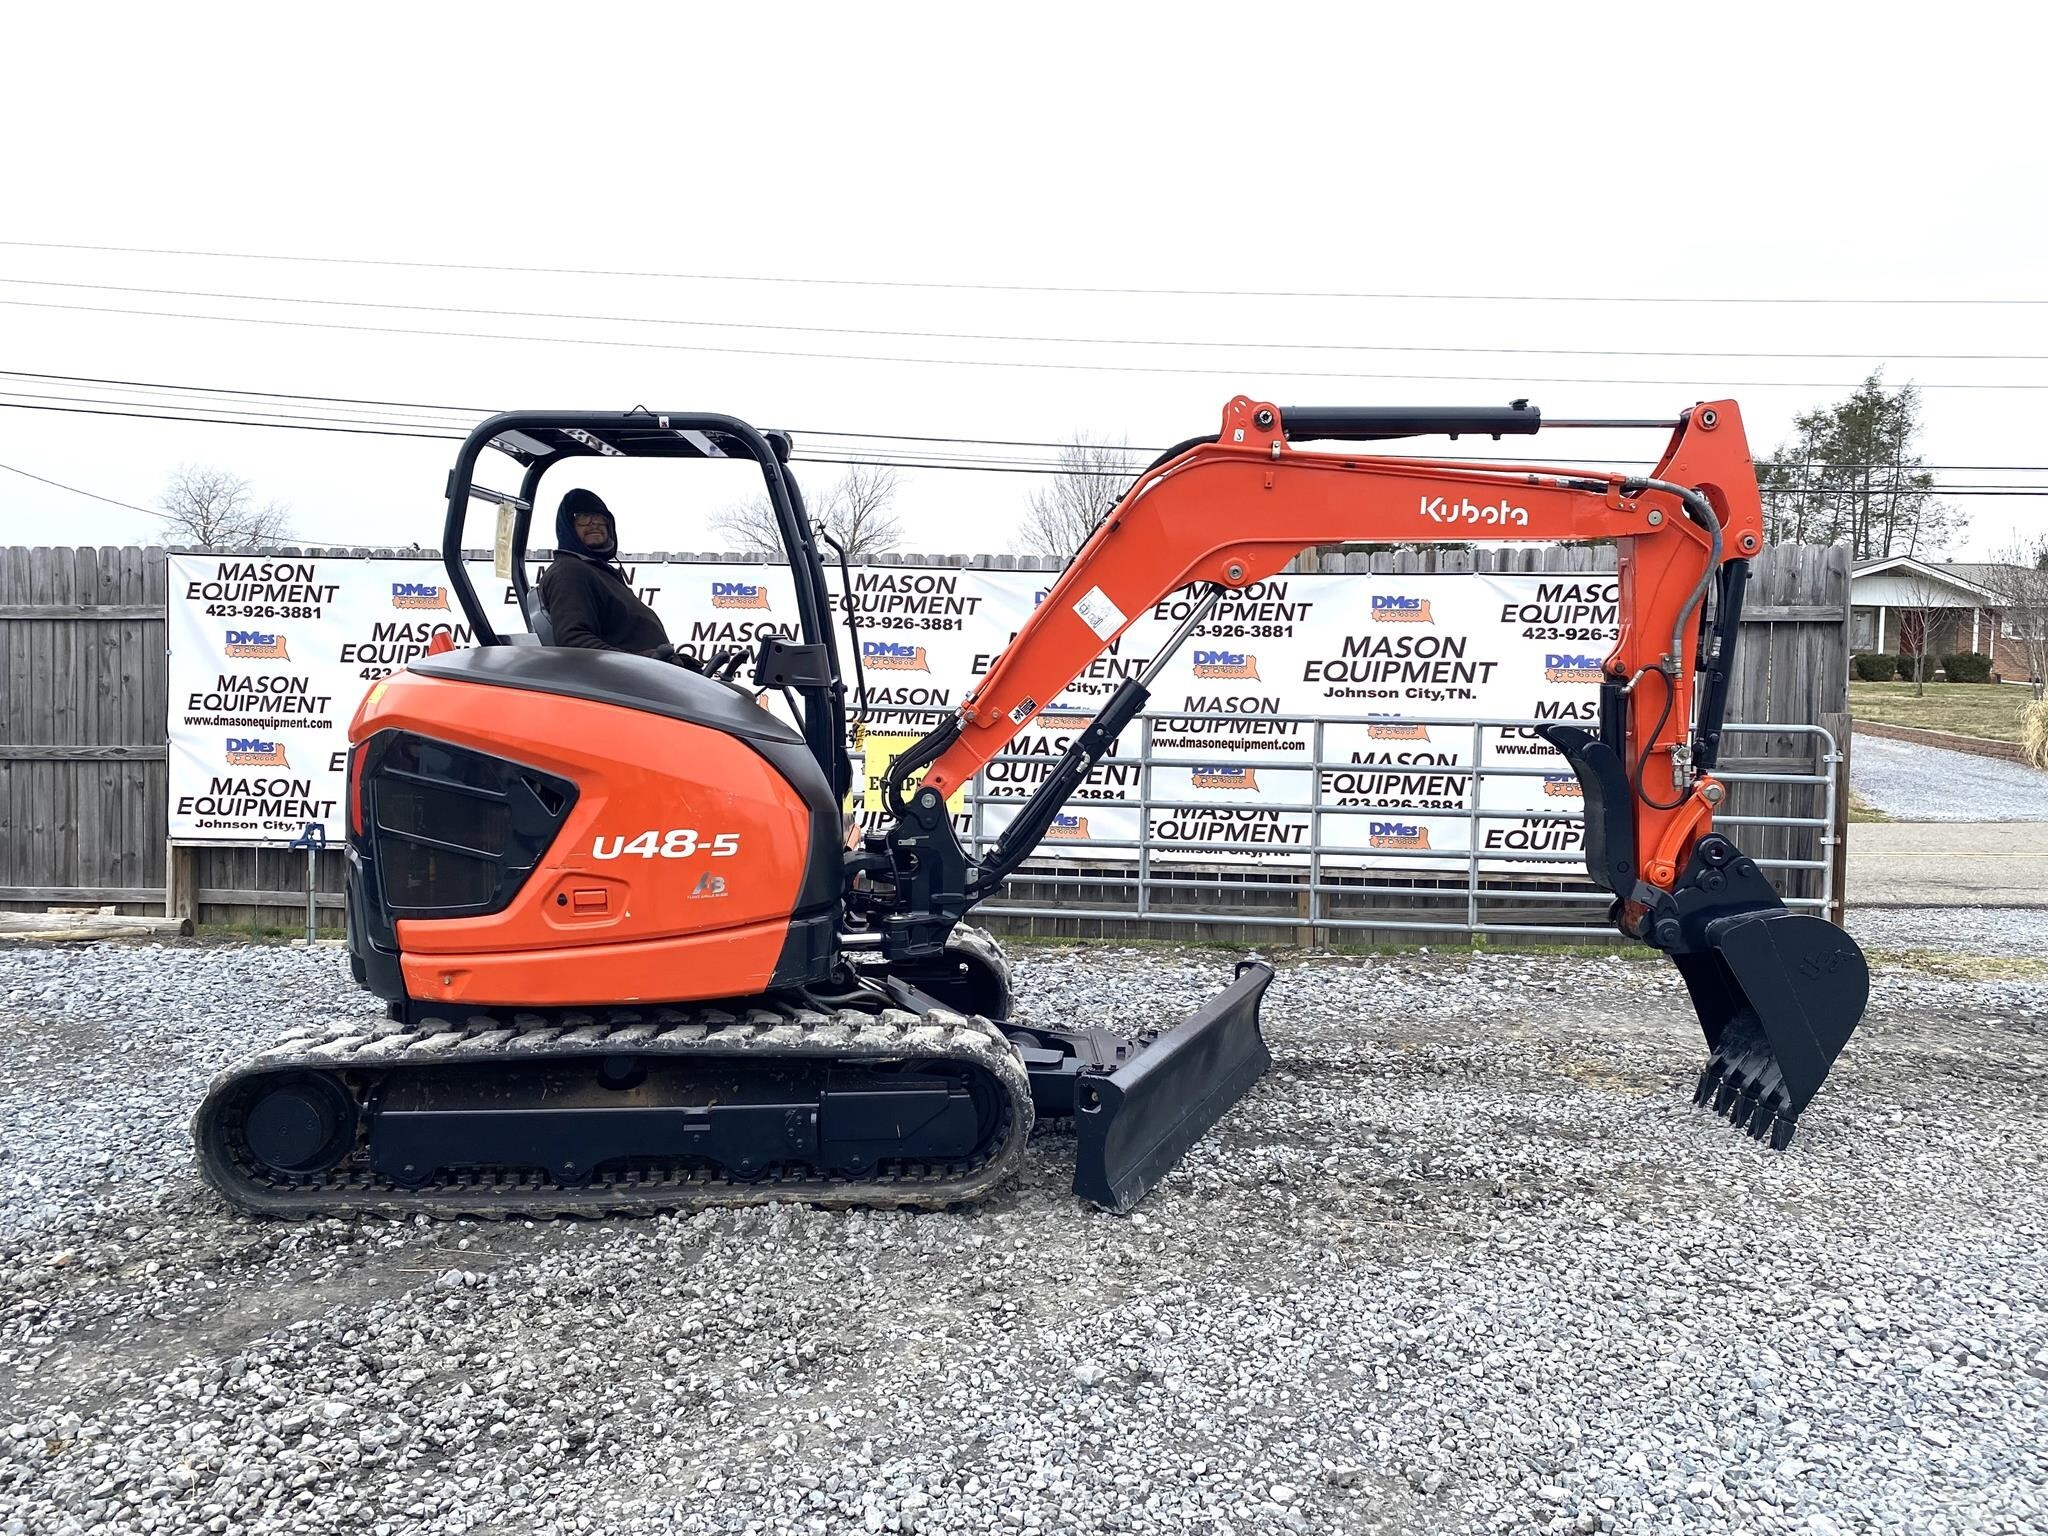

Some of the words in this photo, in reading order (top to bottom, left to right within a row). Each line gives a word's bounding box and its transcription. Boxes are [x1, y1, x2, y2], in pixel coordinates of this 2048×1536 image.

[1420, 496, 1529, 525] Kubota
[217, 562, 315, 583] MASON
[186, 582, 339, 604] EQUIPMENT
[392, 583, 437, 597] DMes
[712, 583, 757, 596] DMes
[855, 573, 957, 594] MASON
[1372, 595, 1420, 609] DMes
[1536, 584, 1619, 603] MASO
[205, 605, 322, 620] 423-926-3881
[828, 593, 982, 616] EQUIPMENT
[842, 616, 963, 631] 423-926-3881
[1500, 604, 1620, 625] EQUIPM
[226, 630, 275, 646] DMes
[1188, 624, 1293, 638] 3-926-3881
[1522, 627, 1620, 641] 423-926-3
[863, 641, 914, 656] DMes
[1341, 635, 1467, 659] MASON
[1194, 650, 1245, 665] DMes
[1303, 660, 1498, 684] EQUIPMENT
[217, 674, 309, 694] MASON
[188, 693, 331, 714] EQUIPMENT
[853, 687, 950, 706] MASON
[1323, 687, 1399, 699] Johnson
[1405, 687, 1477, 701] City,TN.
[1184, 696, 1280, 715] MASON
[1534, 701, 1600, 720] MAS
[184, 715, 332, 730] www.dmasonequipment.com
[226, 738, 275, 754] DMes
[1003, 736, 1119, 757] MASN
[1151, 737, 1305, 752] www.dmasonequipment.com
[1351, 752, 1458, 767] MASON
[985, 762, 1141, 786] QUIPENT
[209, 777, 311, 798] MASON
[177, 796, 336, 819] EQUIPMENT
[195, 819, 258, 830] Johnson
[1150, 820, 1309, 844] EQUIPMENT
[1370, 822, 1418, 836] DMes
[592, 829, 740, 860] U48-5
[1485, 829, 1585, 851] EQUIP
